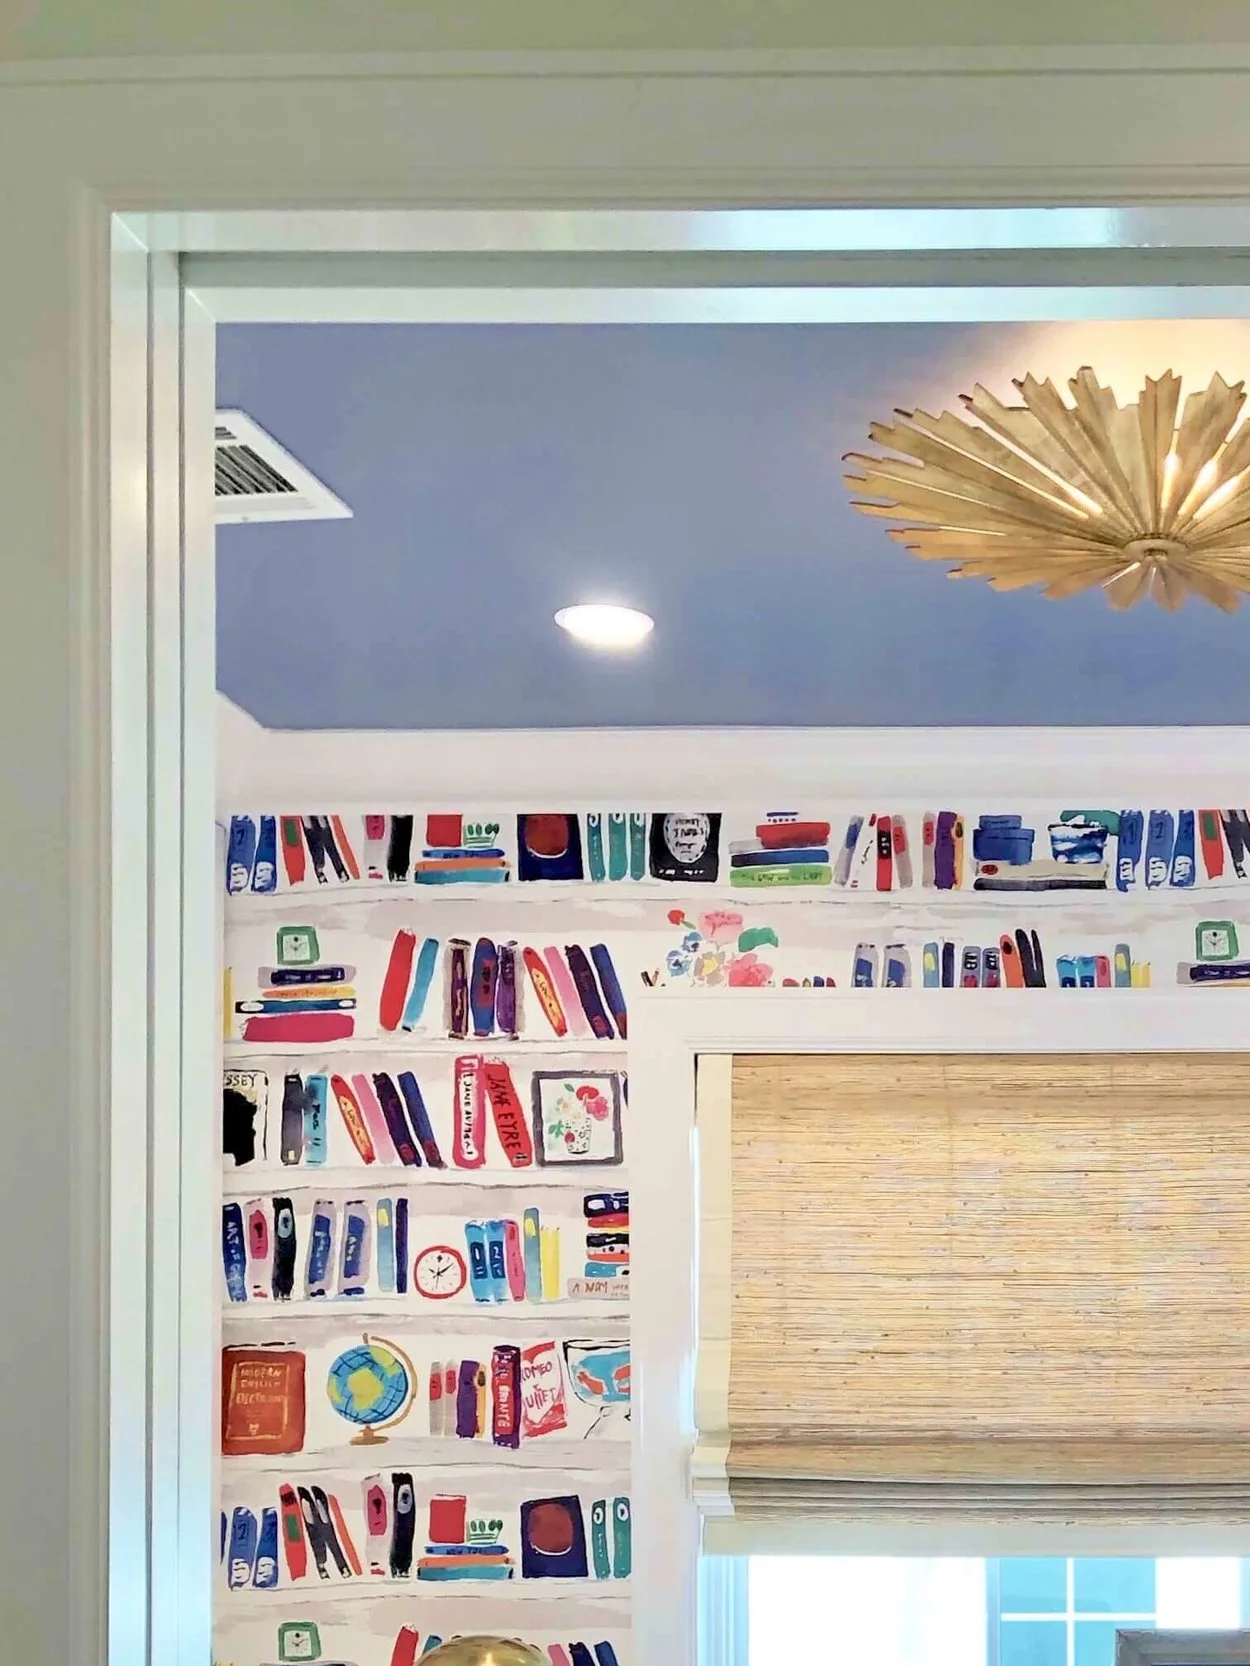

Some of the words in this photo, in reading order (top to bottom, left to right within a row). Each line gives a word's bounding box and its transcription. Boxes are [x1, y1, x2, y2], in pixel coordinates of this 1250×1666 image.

[223, 1073, 257, 1087] SSEY
[486, 1074, 512, 1107] JANE
[226, 1221, 240, 1245] ART
[525, 1387, 556, 1409] ULIET
